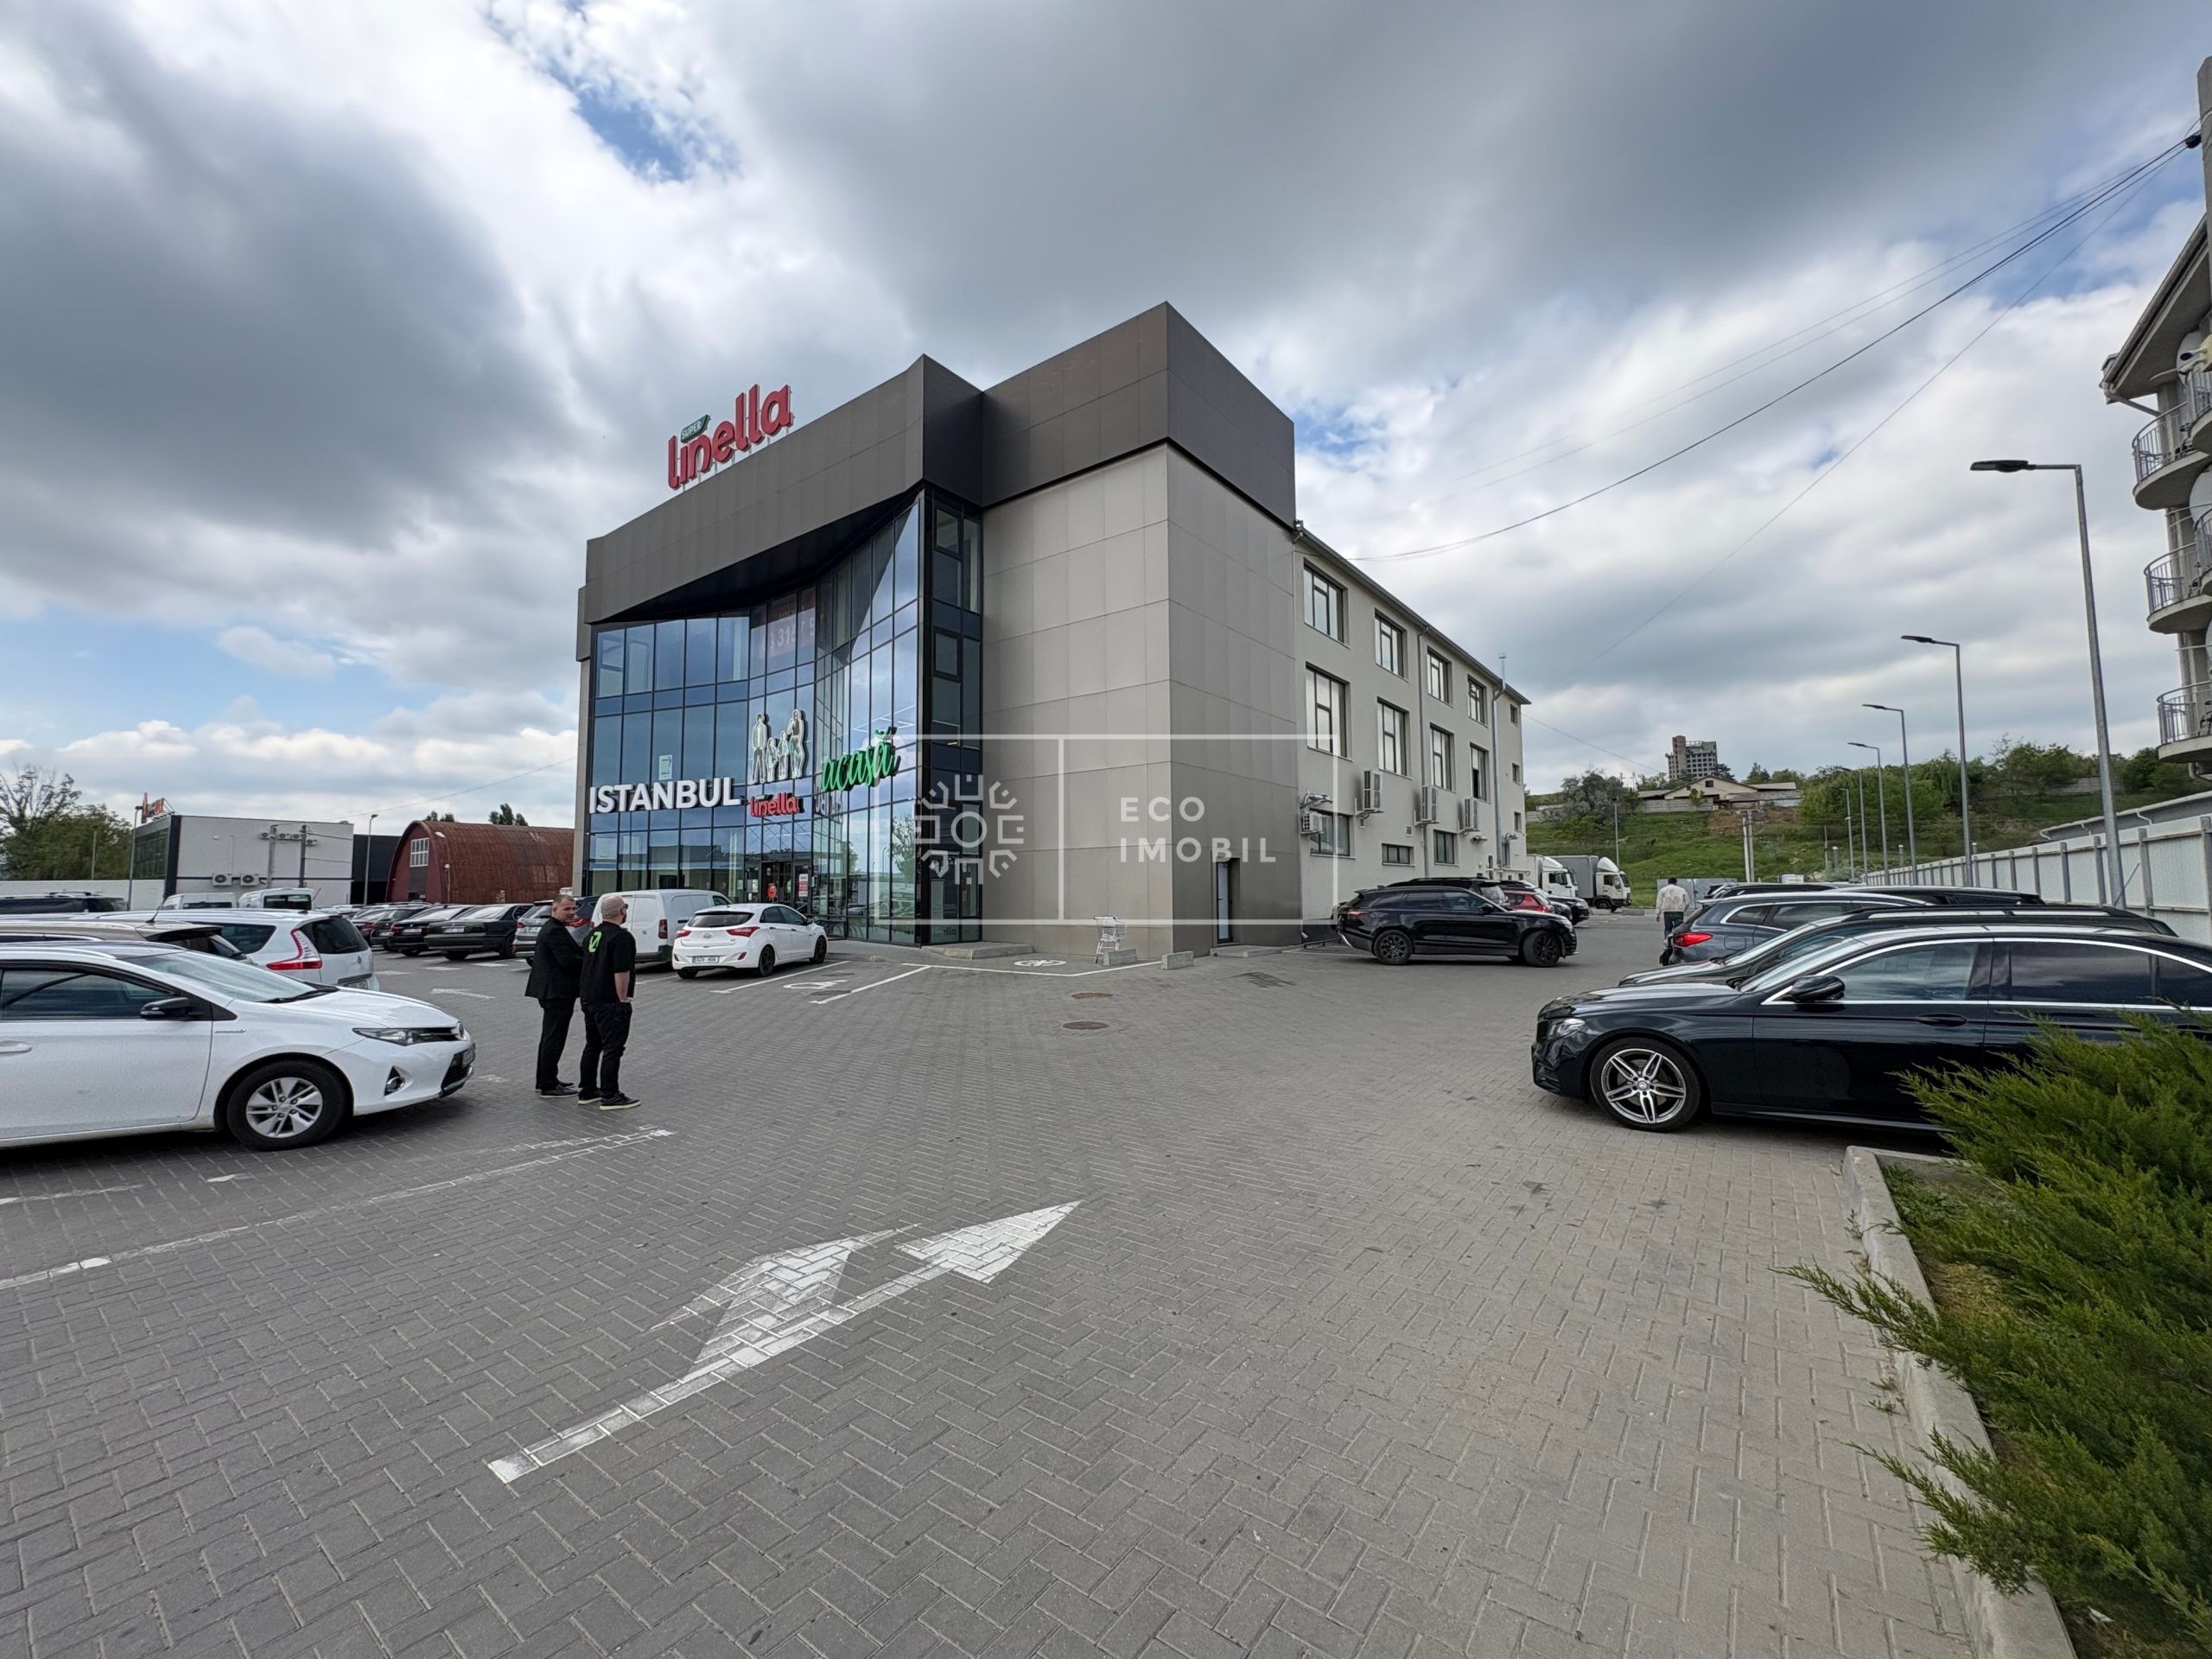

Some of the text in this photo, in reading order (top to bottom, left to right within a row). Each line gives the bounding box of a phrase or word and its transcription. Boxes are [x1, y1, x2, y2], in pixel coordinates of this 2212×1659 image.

[668, 384, 792, 489] linella
[681, 420, 702, 440] SUPER
[821, 728, 899, 792] acasă
[589, 777, 741, 814] ISTANBUL
[749, 791, 800, 817] linella
